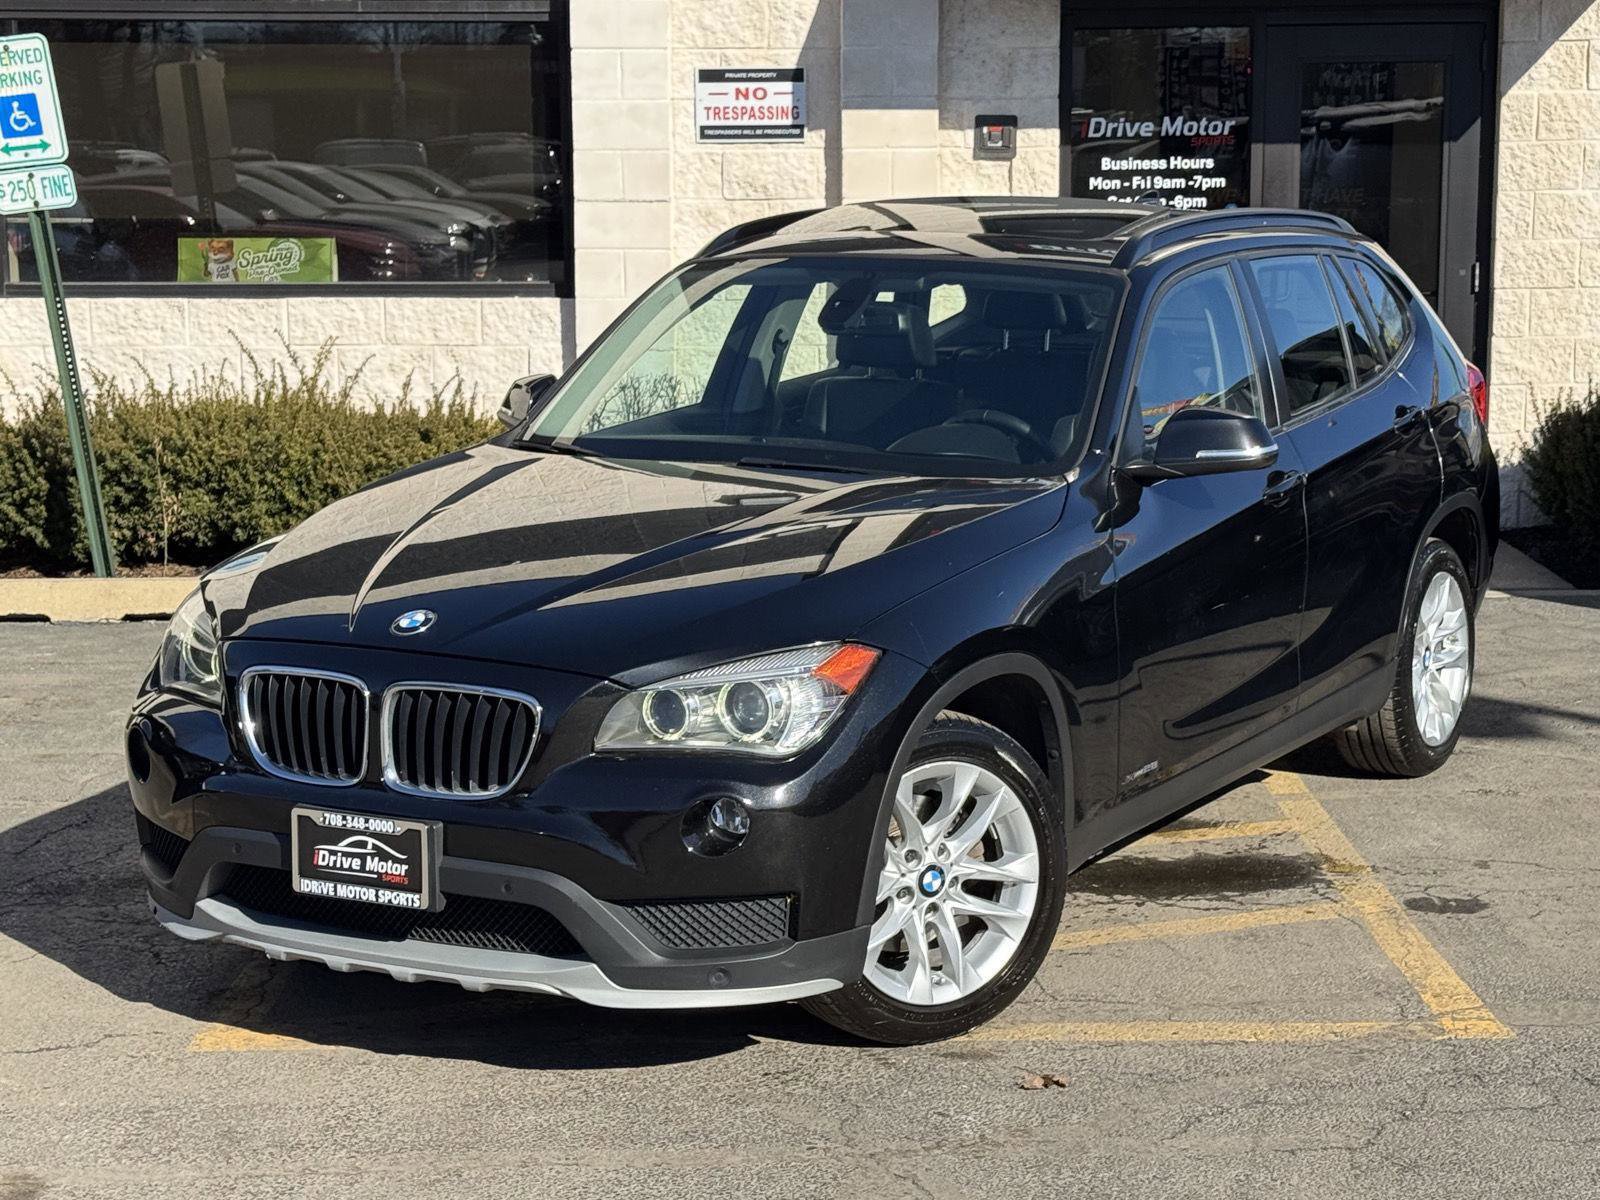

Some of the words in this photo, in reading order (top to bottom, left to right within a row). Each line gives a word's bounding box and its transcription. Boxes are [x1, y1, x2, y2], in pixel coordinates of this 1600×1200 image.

[0, 48, 42, 66] ERVED
[0, 70, 43, 88] RKING
[735, 87, 768, 101] NO
[704, 105, 800, 121] TRESPASSING
[1160, 115, 1236, 137] Motor
[1190, 136, 1235, 146] SPORTS
[1101, 157, 1168, 171] Business
[1169, 156, 1215, 170] Hours
[41, 174, 71, 199] FINE
[1089, 177, 1122, 190] Mon
[1153, 176, 1187, 188] 9am
[239, 248, 293, 268] Spring
[324, 813, 394, 833] 708-348-0000
[313, 849, 362, 870] iDrive
[365, 855, 409, 876] Motor
[382, 873, 409, 885] SPORTS
[300, 879, 335, 896] IDRIVE
[336, 884, 377, 902] MOTOR
[377, 889, 421, 908] SPORTS
